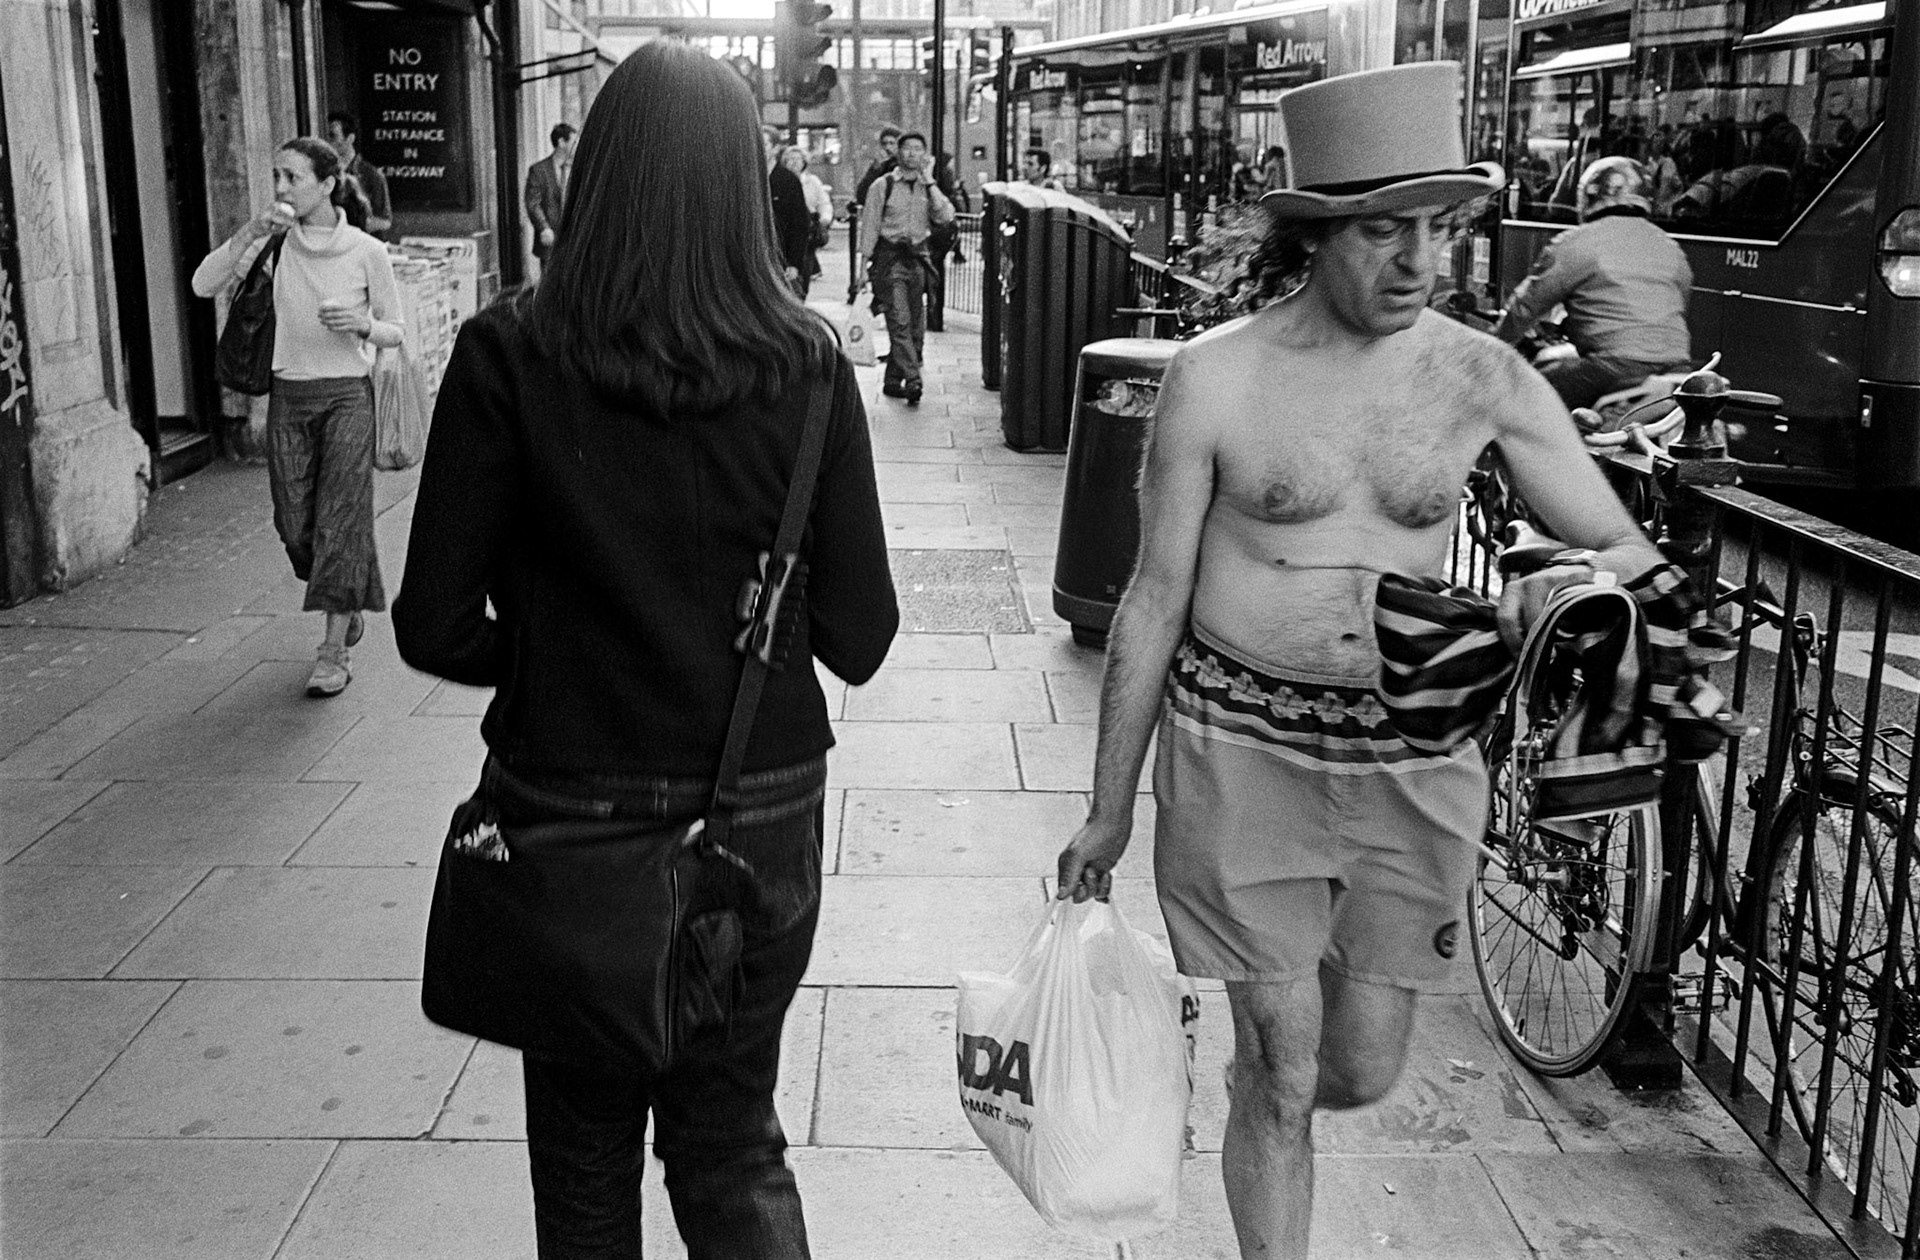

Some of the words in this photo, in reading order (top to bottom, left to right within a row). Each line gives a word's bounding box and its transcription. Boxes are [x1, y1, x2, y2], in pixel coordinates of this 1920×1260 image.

[389, 48, 421, 65] NO
[1257, 40, 1281, 69] Red
[1282, 39, 1326, 67] Arrow
[374, 73, 439, 91] ENTRY
[382, 110, 437, 122] STATION
[375, 129, 445, 141] ENTRANCE
[403, 147, 418, 159] IN
[1726, 249, 1759, 268] MAL22
[958, 1033, 1034, 1106] DA
[1005, 1111, 1033, 1134] family
